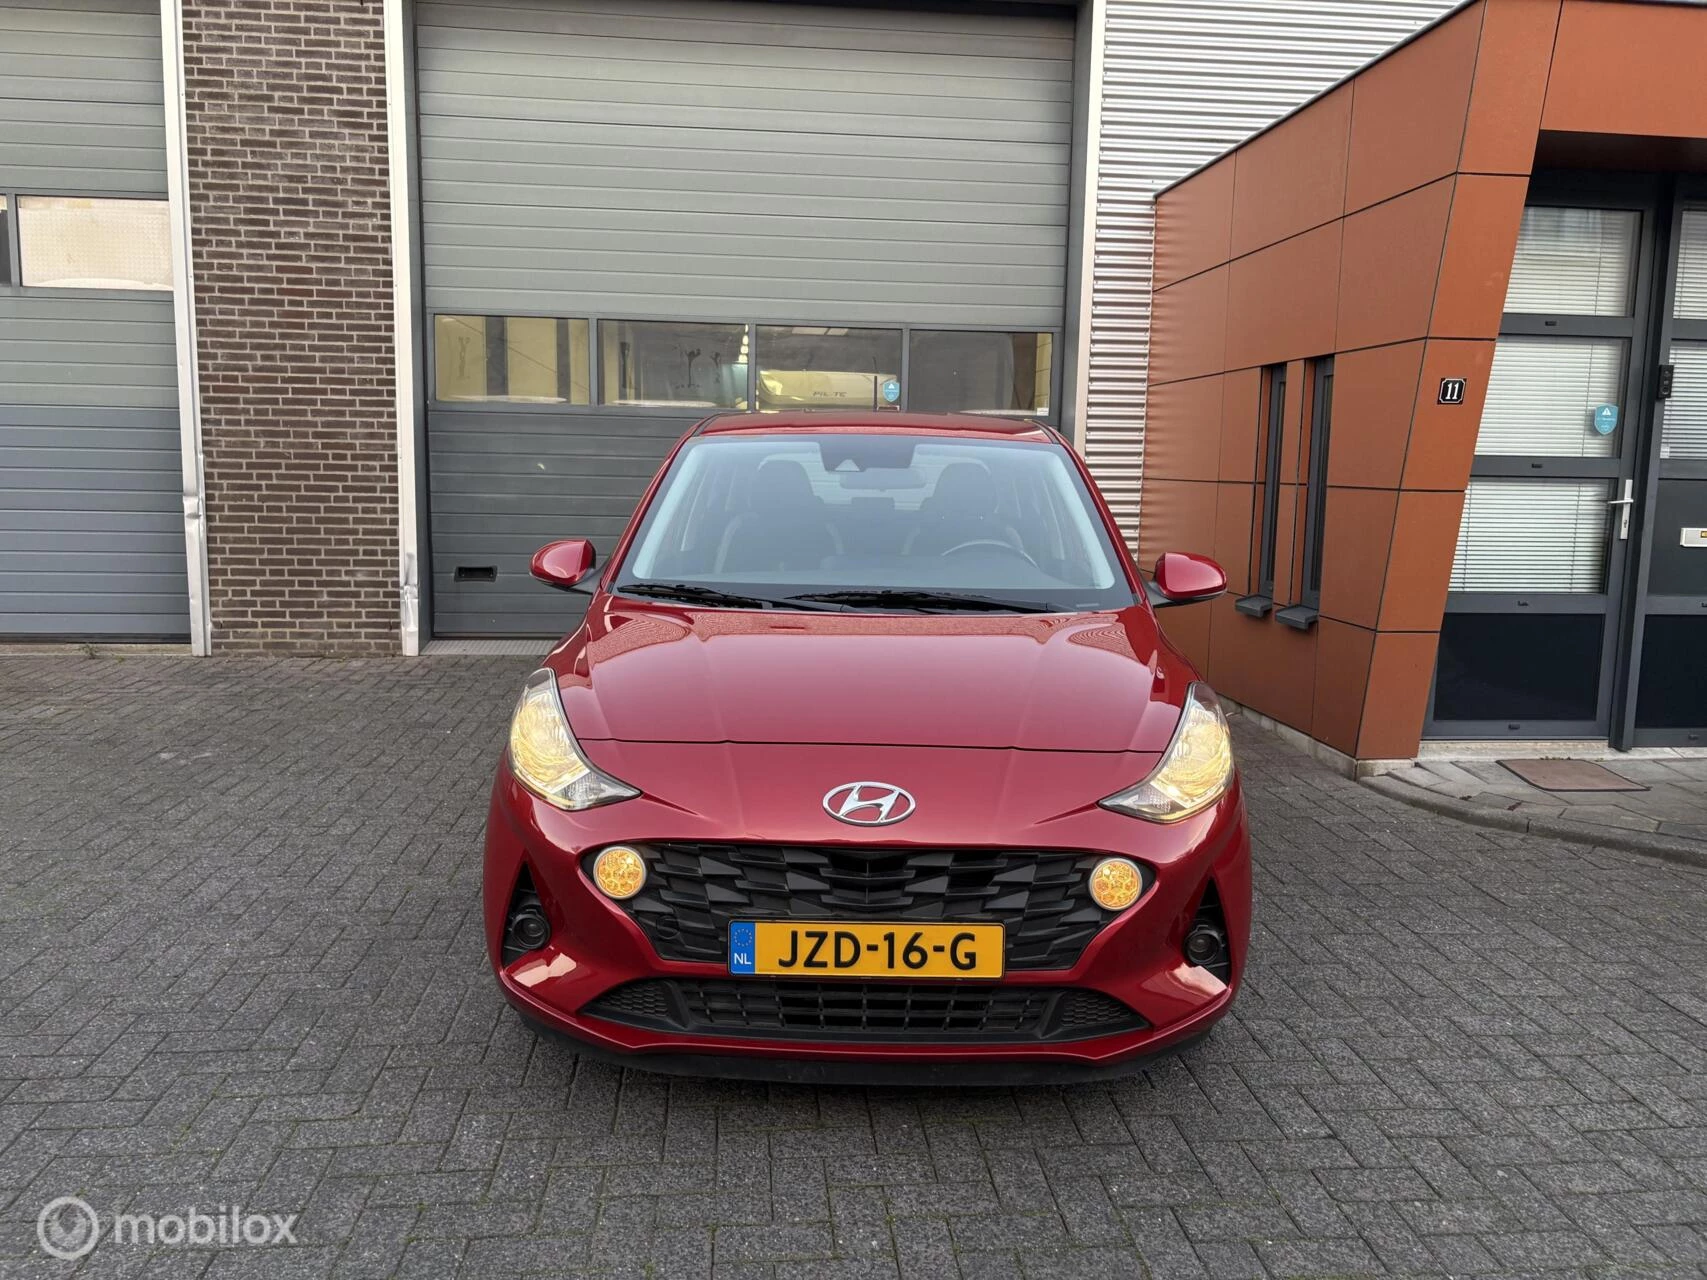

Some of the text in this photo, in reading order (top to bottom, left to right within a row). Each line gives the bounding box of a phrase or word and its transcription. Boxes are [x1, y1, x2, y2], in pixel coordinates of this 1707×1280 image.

[1445, 382, 1459, 400] 11
[734, 952, 751, 965] NL
[778, 930, 977, 970] JZD-16-G
